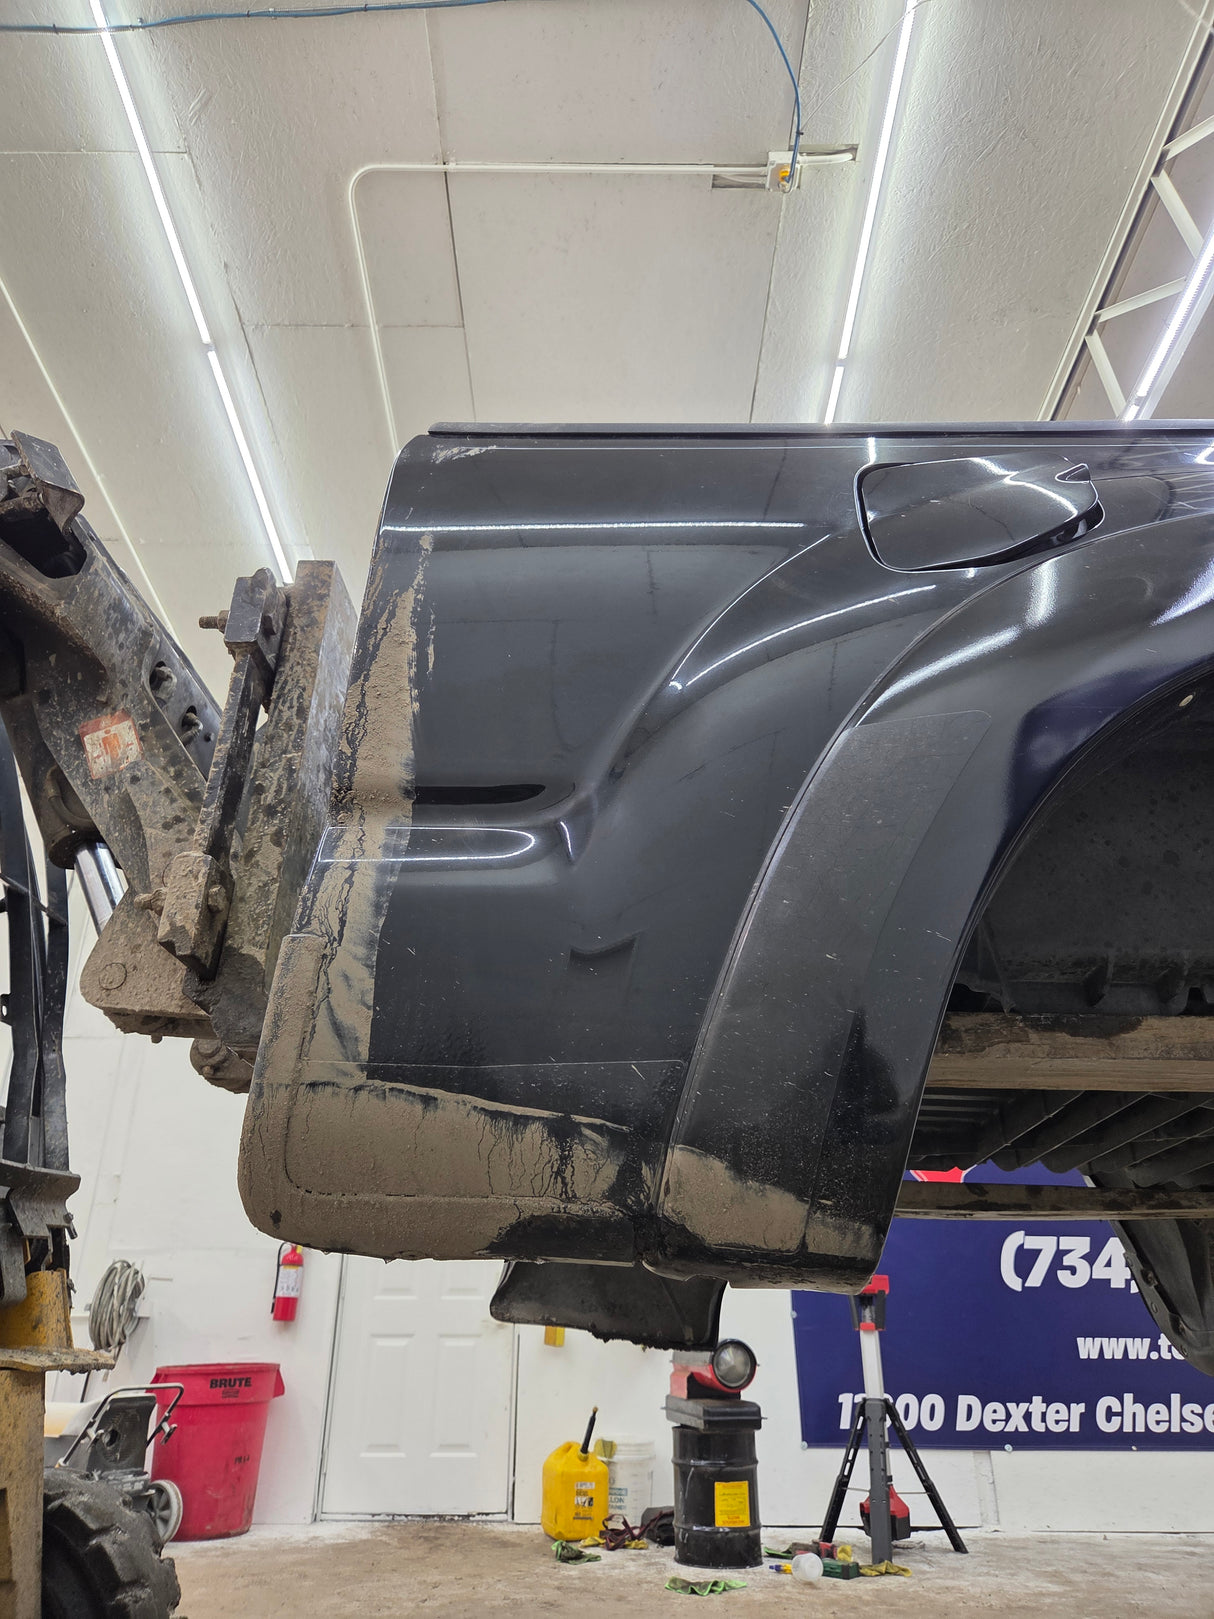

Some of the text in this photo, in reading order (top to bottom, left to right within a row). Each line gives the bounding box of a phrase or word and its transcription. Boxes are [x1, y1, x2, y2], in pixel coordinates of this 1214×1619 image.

[1000, 1230, 1140, 1294] (734
[209, 1377, 252, 1390] BRUTE
[838, 1392, 946, 1432] 100
[956, 1394, 1086, 1433] Dexter
